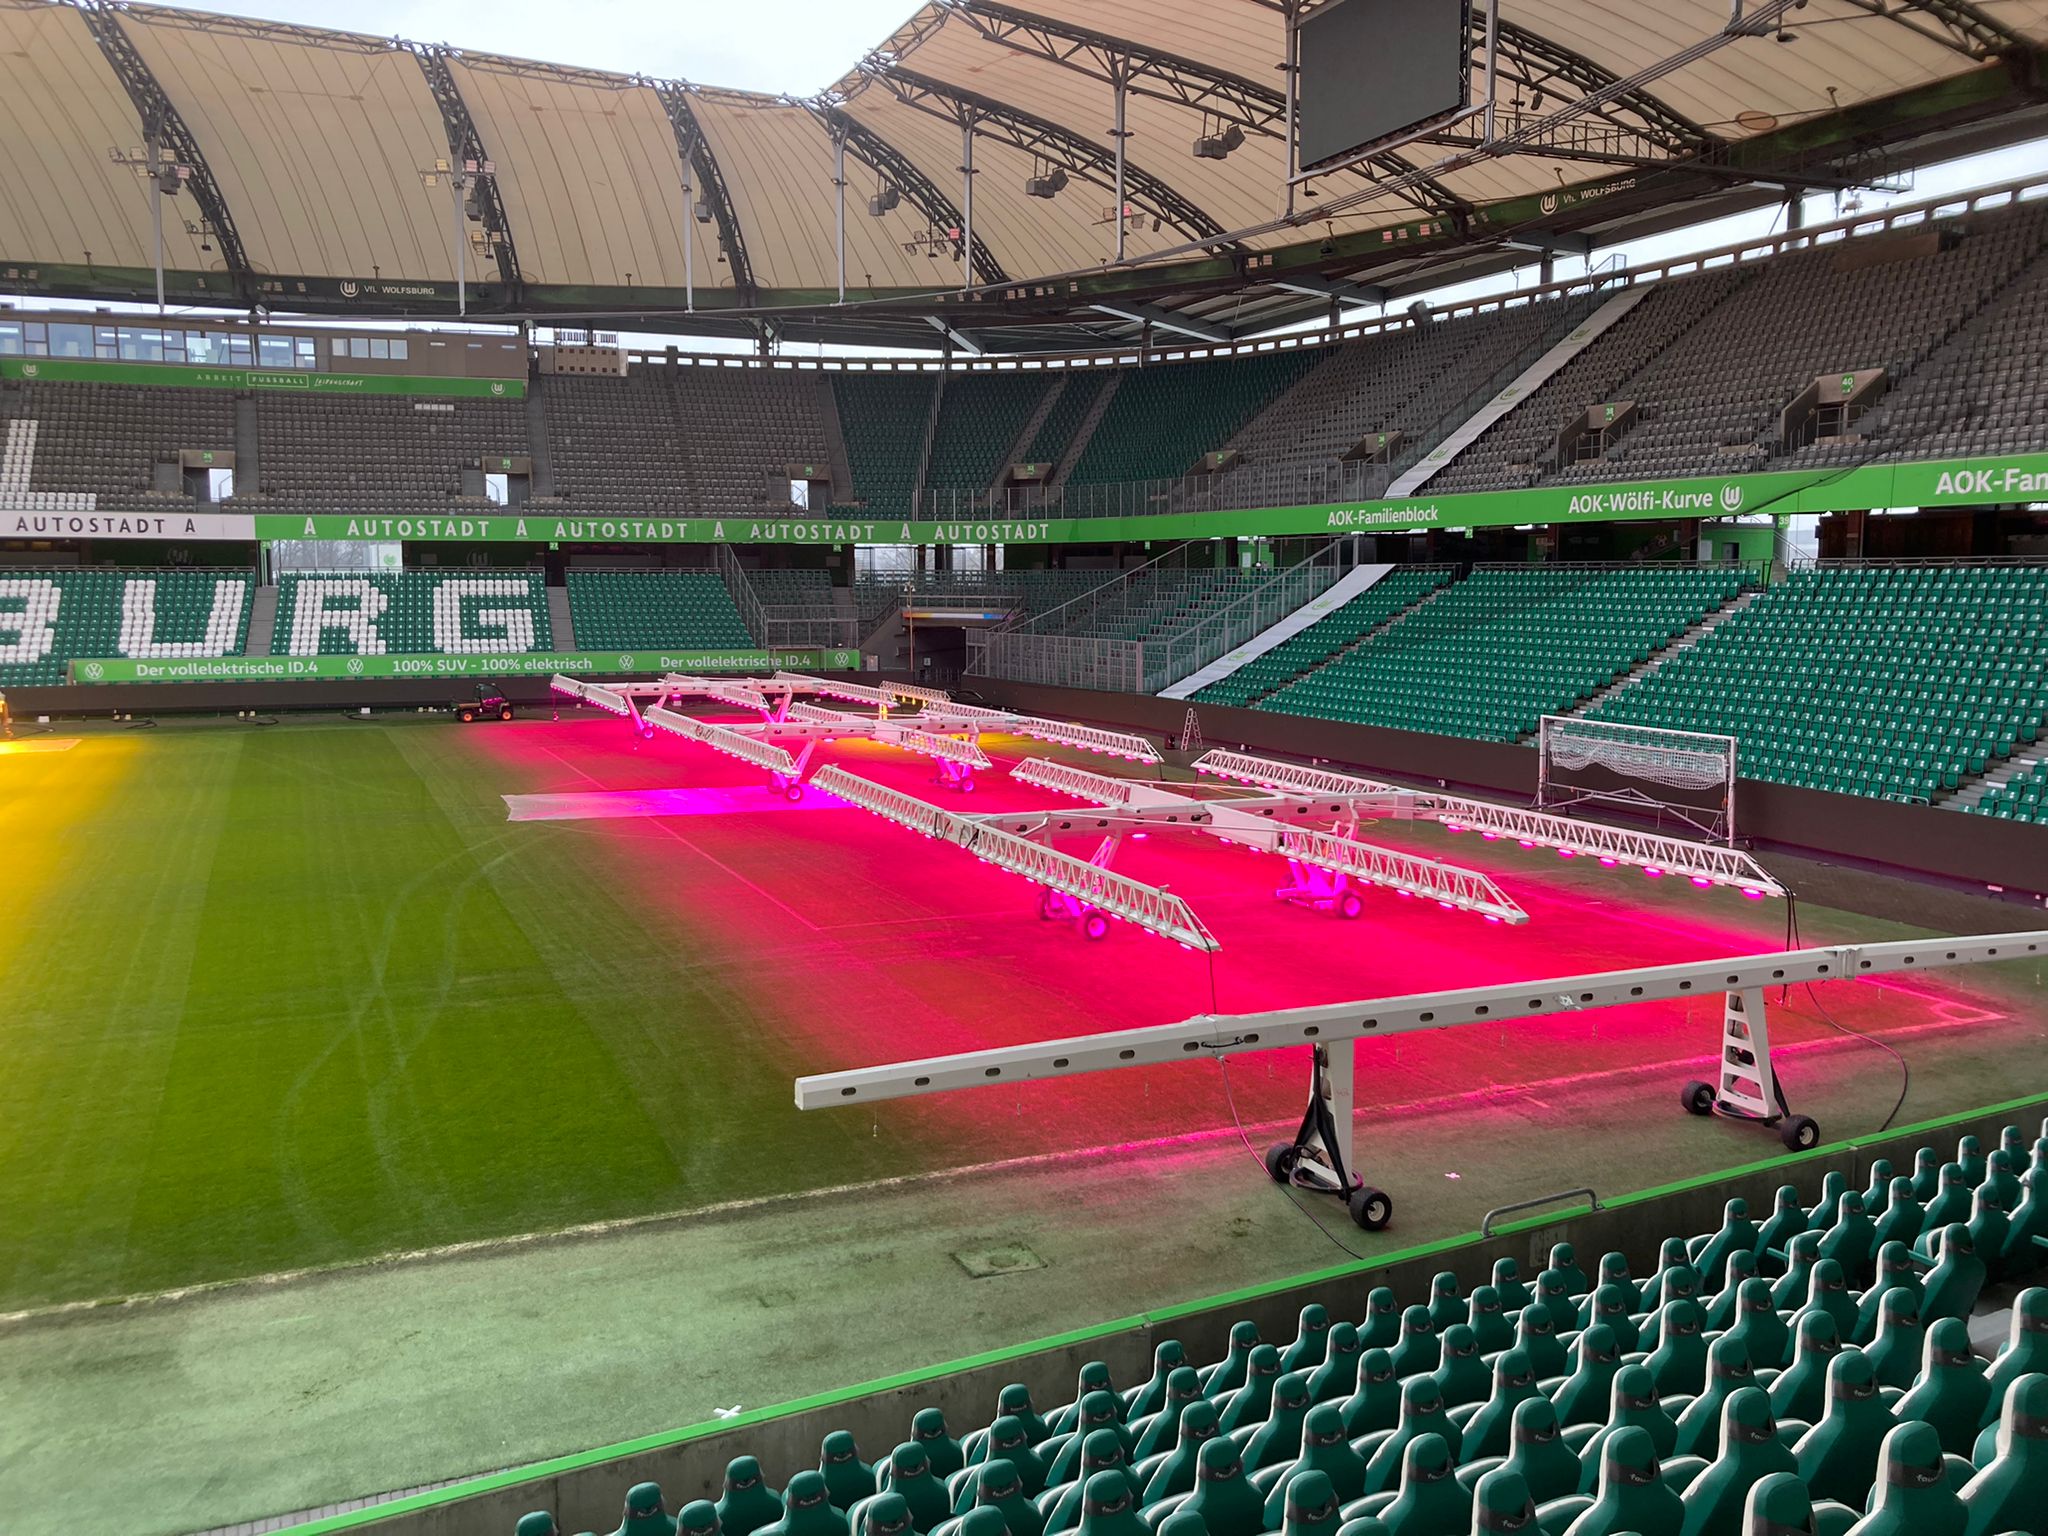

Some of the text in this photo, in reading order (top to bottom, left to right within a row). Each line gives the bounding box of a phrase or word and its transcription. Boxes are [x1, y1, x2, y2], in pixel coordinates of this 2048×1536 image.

[364, 285, 377, 293] VfL
[381, 286, 435, 295] WOLFSBURG
[252, 376, 304, 384] FUSSBALL
[1842, 377, 1853, 386] 40
[1568, 490, 1713, 514] AOK-Wölfi-Kurve
[1327, 504, 1439, 526] AOK-Familienblock
[1778, 515, 1790, 526] 39
[16, 517, 196, 534] AUTOSTADT A
[304, 517, 1050, 541] A AUTOSTADT A AUTOSTADT A AUTOSTADT A AUTOSTADT
[136, 664, 164, 676] Der
[168, 661, 284, 676] vollelektrische
[288, 661, 318, 674] ID.4
[393, 659, 433, 672] 100%
[437, 659, 468, 671] SUV
[481, 658, 521, 671] 100%
[524, 657, 593, 670] elektrisch
[660, 656, 683, 668] Der
[686, 655, 782, 668] vollelektrische
[785, 655, 811, 666] ID.4
